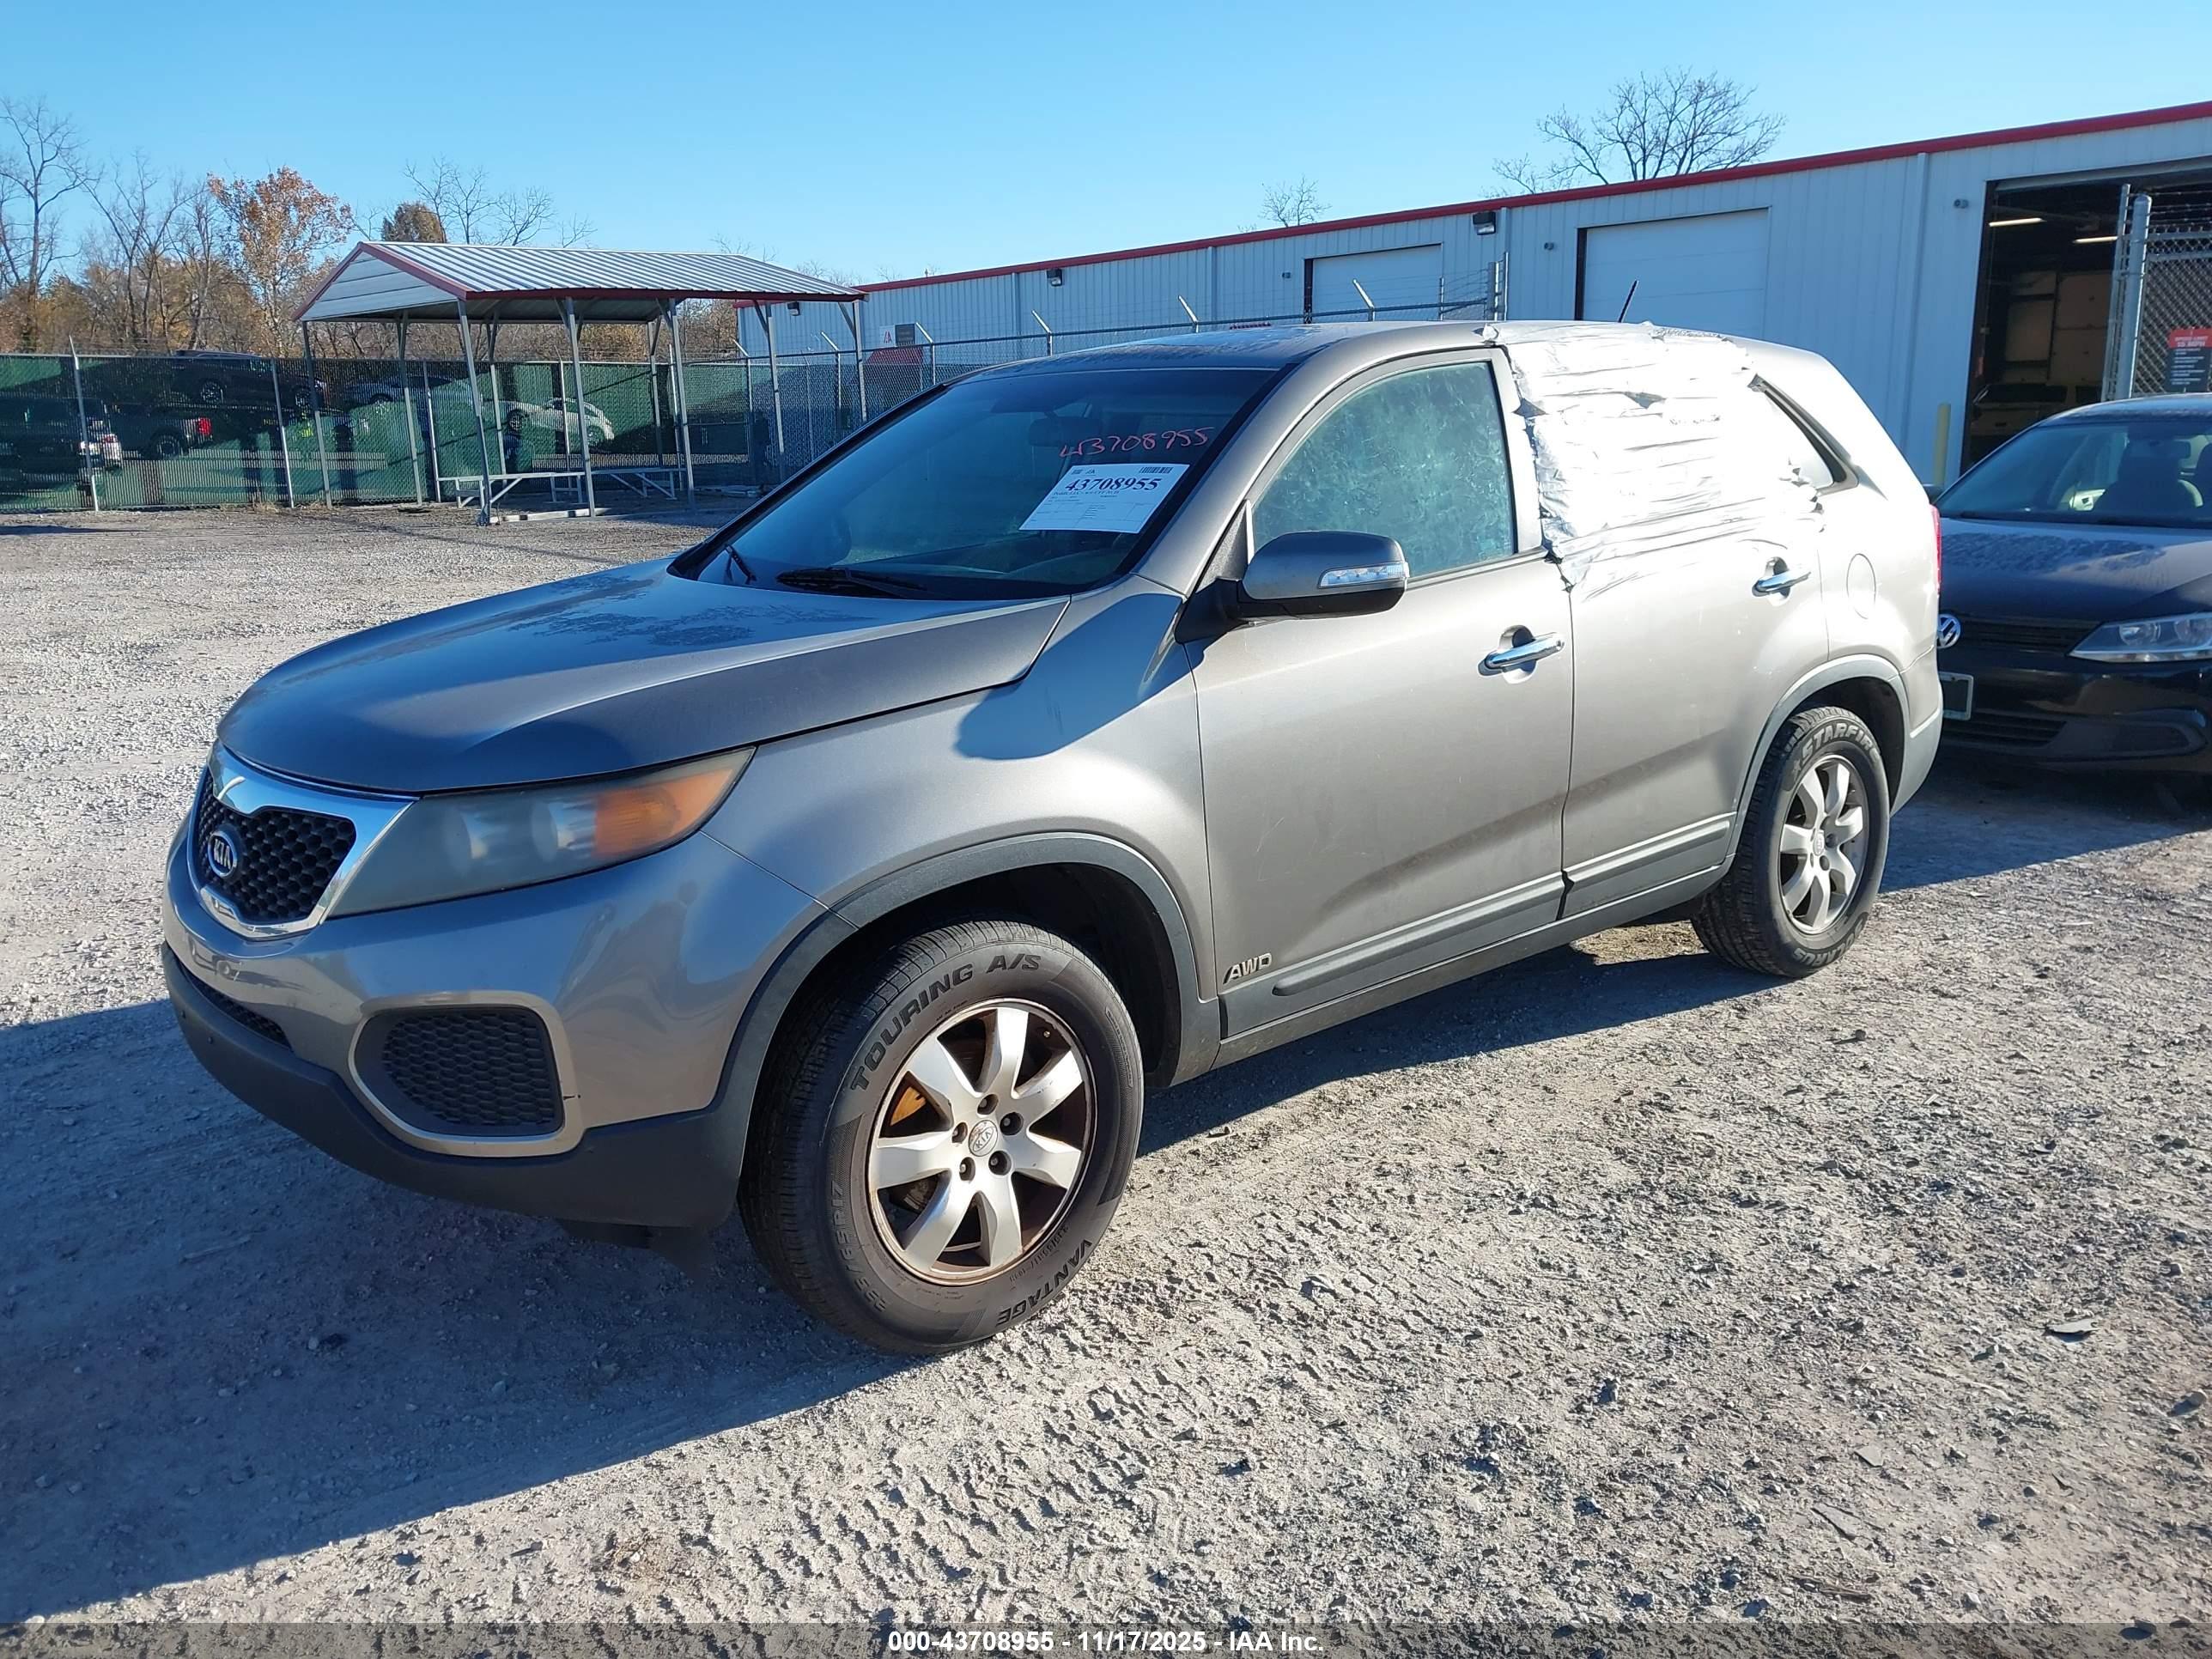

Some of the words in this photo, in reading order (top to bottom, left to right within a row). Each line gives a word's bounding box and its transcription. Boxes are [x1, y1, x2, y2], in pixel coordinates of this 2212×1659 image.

[1060, 427, 1215, 458] 43708955
[1065, 477, 1163, 491] 43708955
[214, 838, 231, 870] KIA
[1223, 952, 1273, 984] AWD
[850, 963, 974, 1091] TOURING
[985, 952, 1042, 974] A/S
[975, 1131, 992, 1149] KIA
[994, 1238, 1093, 1328] VANTAGE
